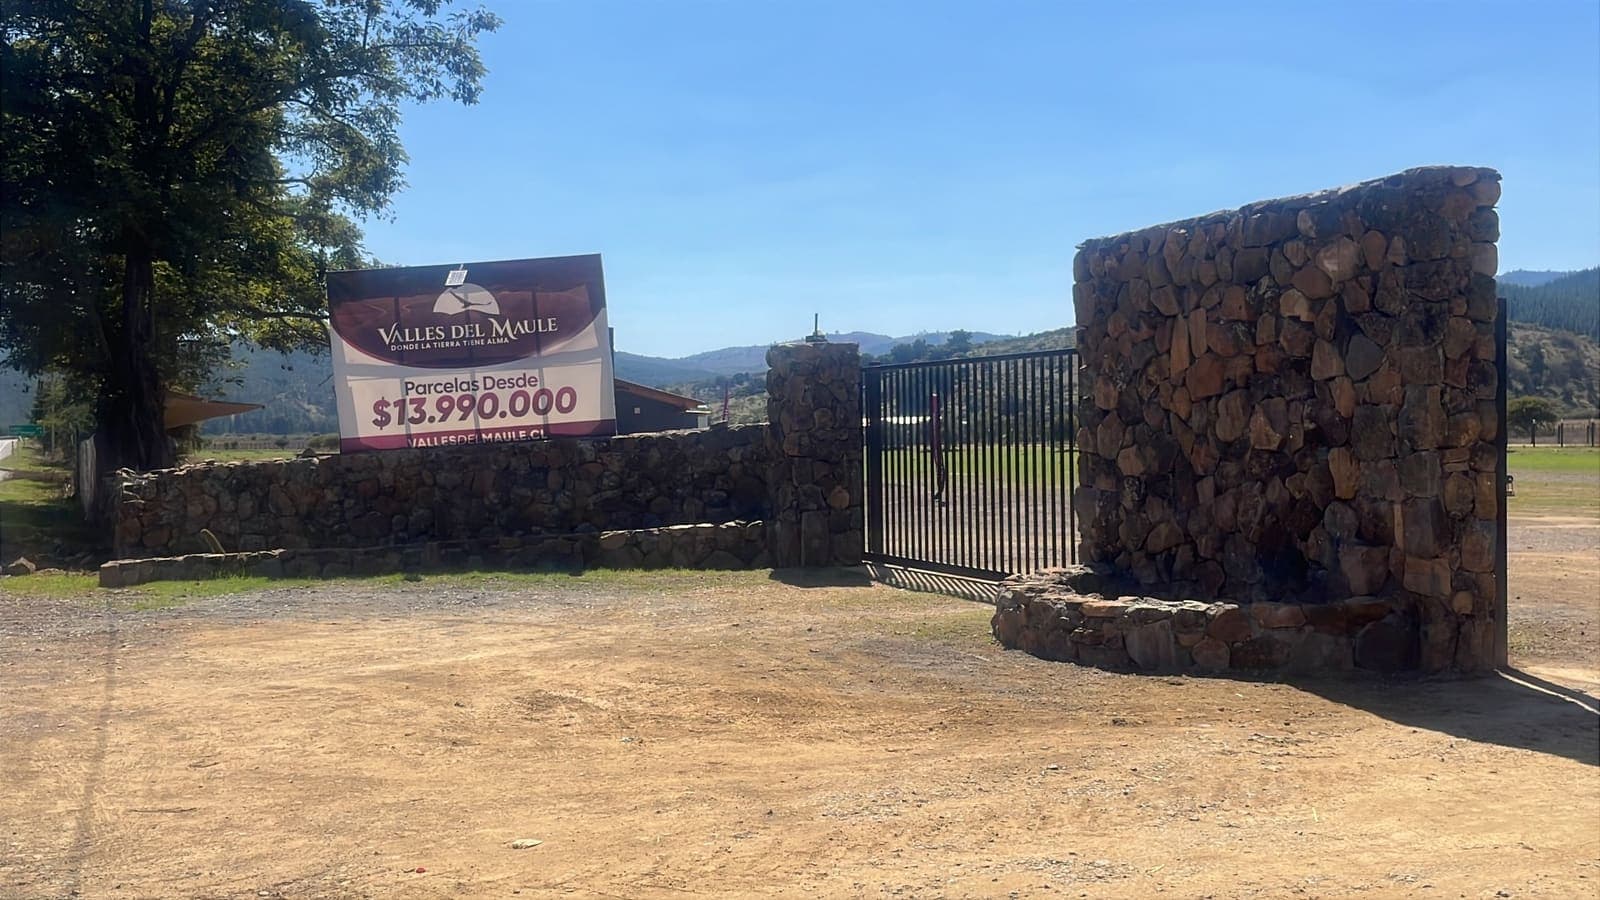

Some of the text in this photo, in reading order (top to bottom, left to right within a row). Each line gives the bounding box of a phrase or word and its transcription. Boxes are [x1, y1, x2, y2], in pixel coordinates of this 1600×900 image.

[378, 317, 558, 345] VALLES DEL MAULE
[391, 343, 419, 351] DONDE
[404, 372, 538, 395] Parcelas Desde
[372, 386, 578, 430] $13.990.000
